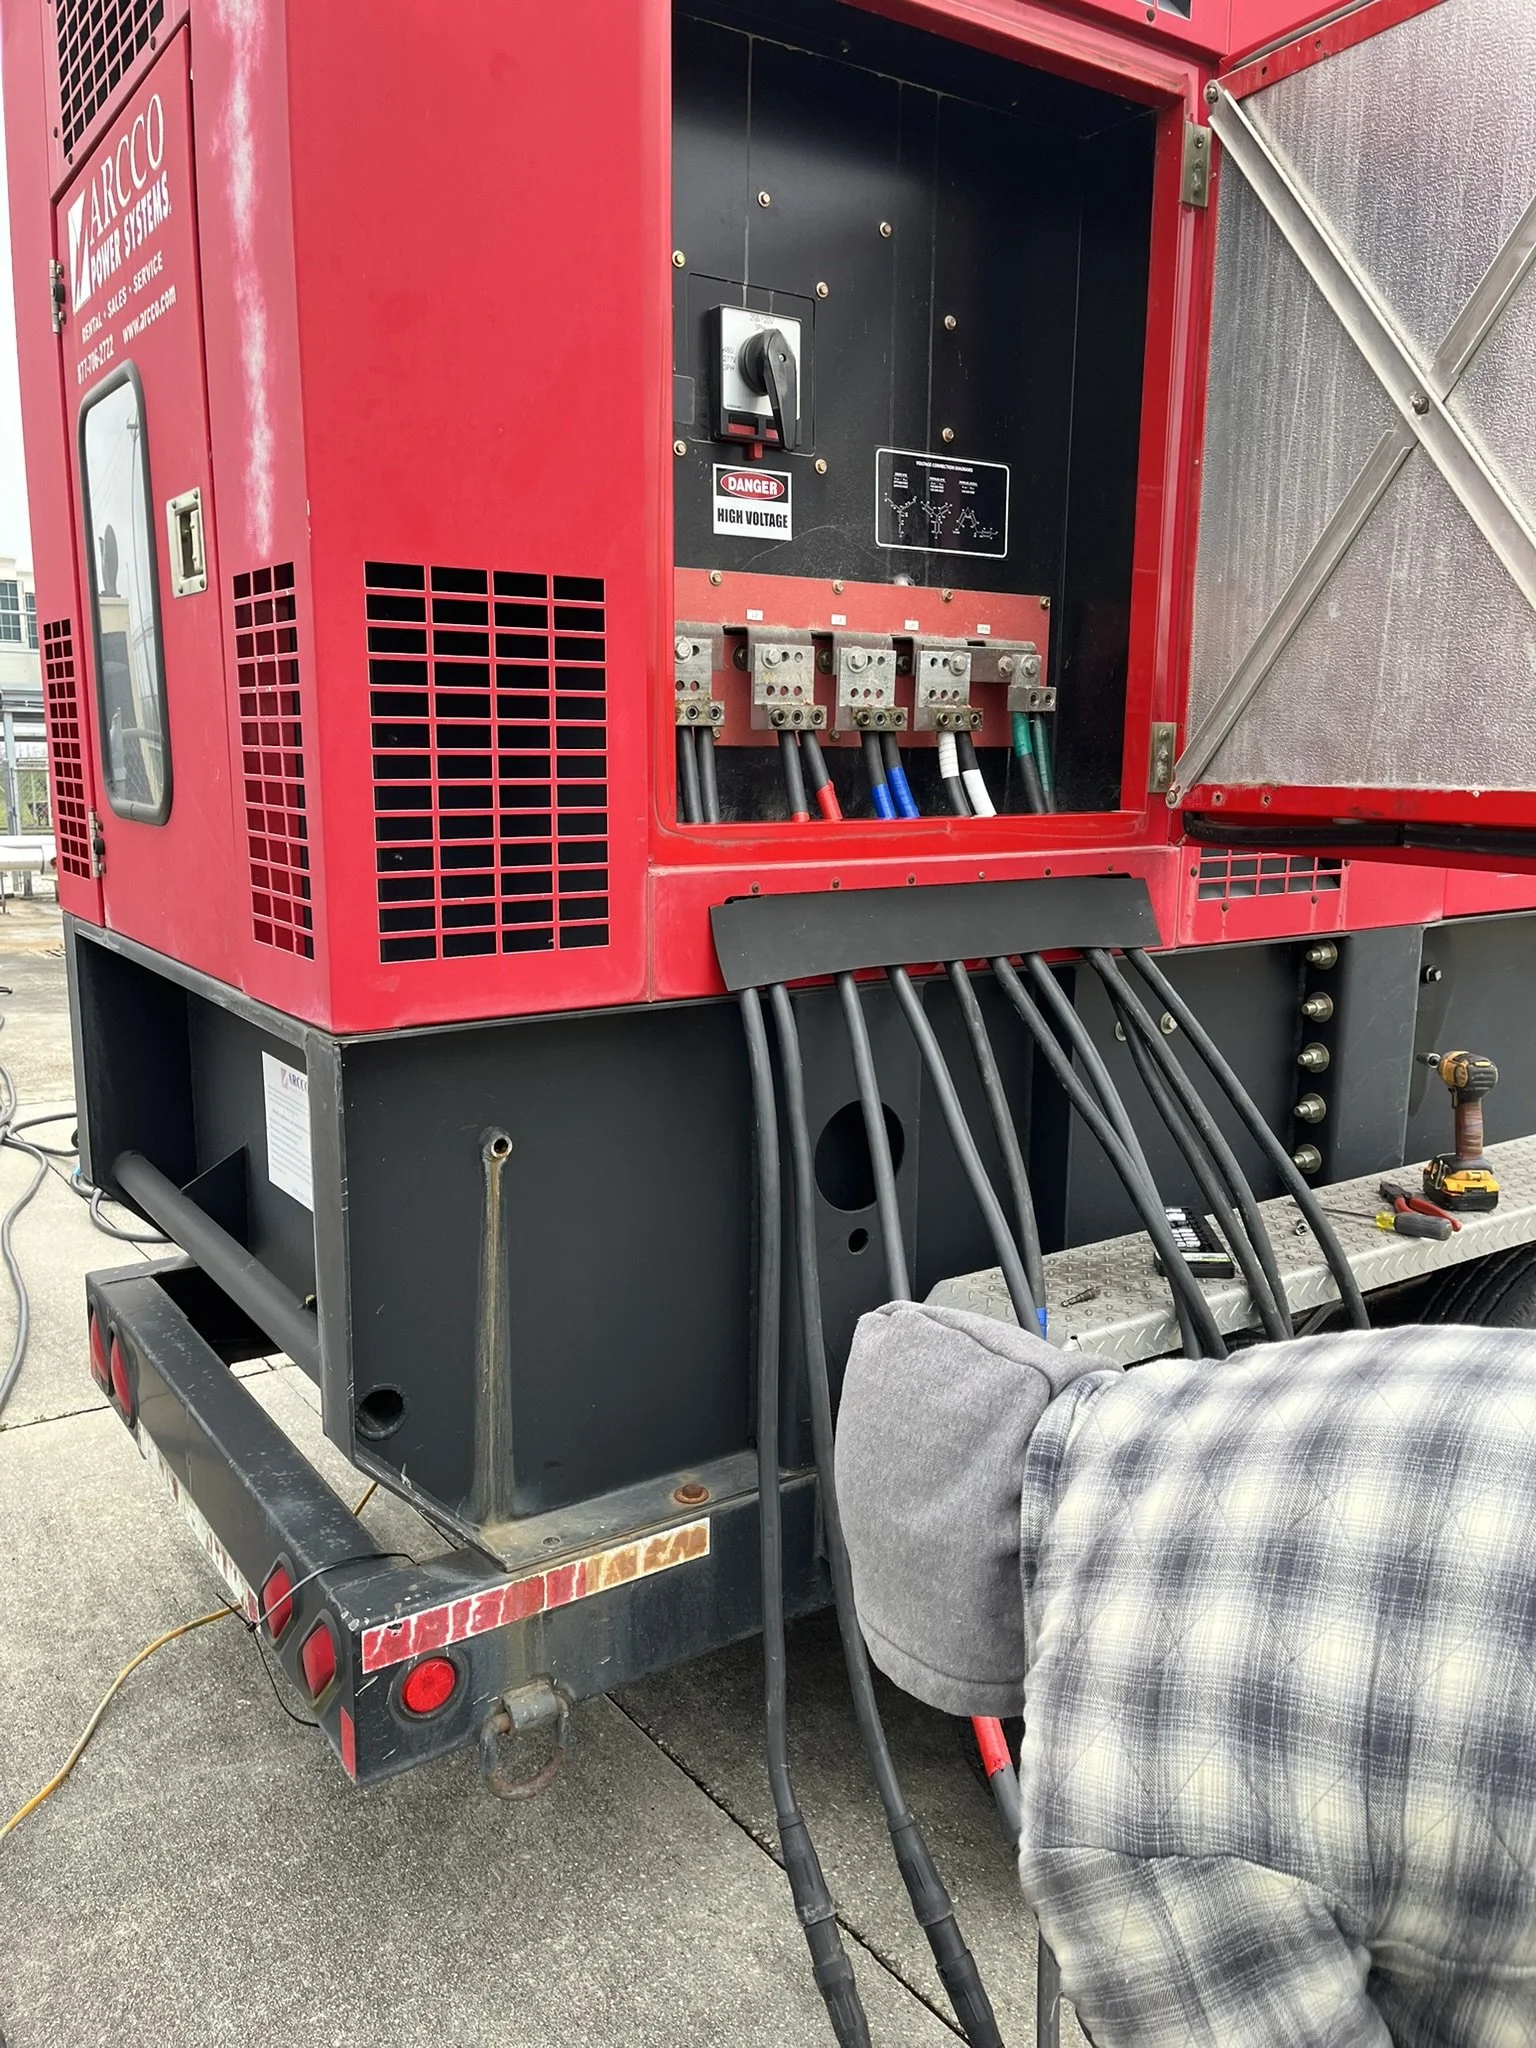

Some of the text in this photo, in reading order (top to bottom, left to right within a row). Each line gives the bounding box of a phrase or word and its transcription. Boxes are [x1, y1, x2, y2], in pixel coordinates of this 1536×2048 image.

[89, 93, 165, 246] ARCCO
[89, 236, 121, 293] POWER
[81, 250, 164, 344] RENTAL SALES SERVICE
[122, 284, 177, 345] www.arcco.com
[727, 474, 778, 496] DANGER
[717, 507, 789, 529] HIGH VOLTAGE
